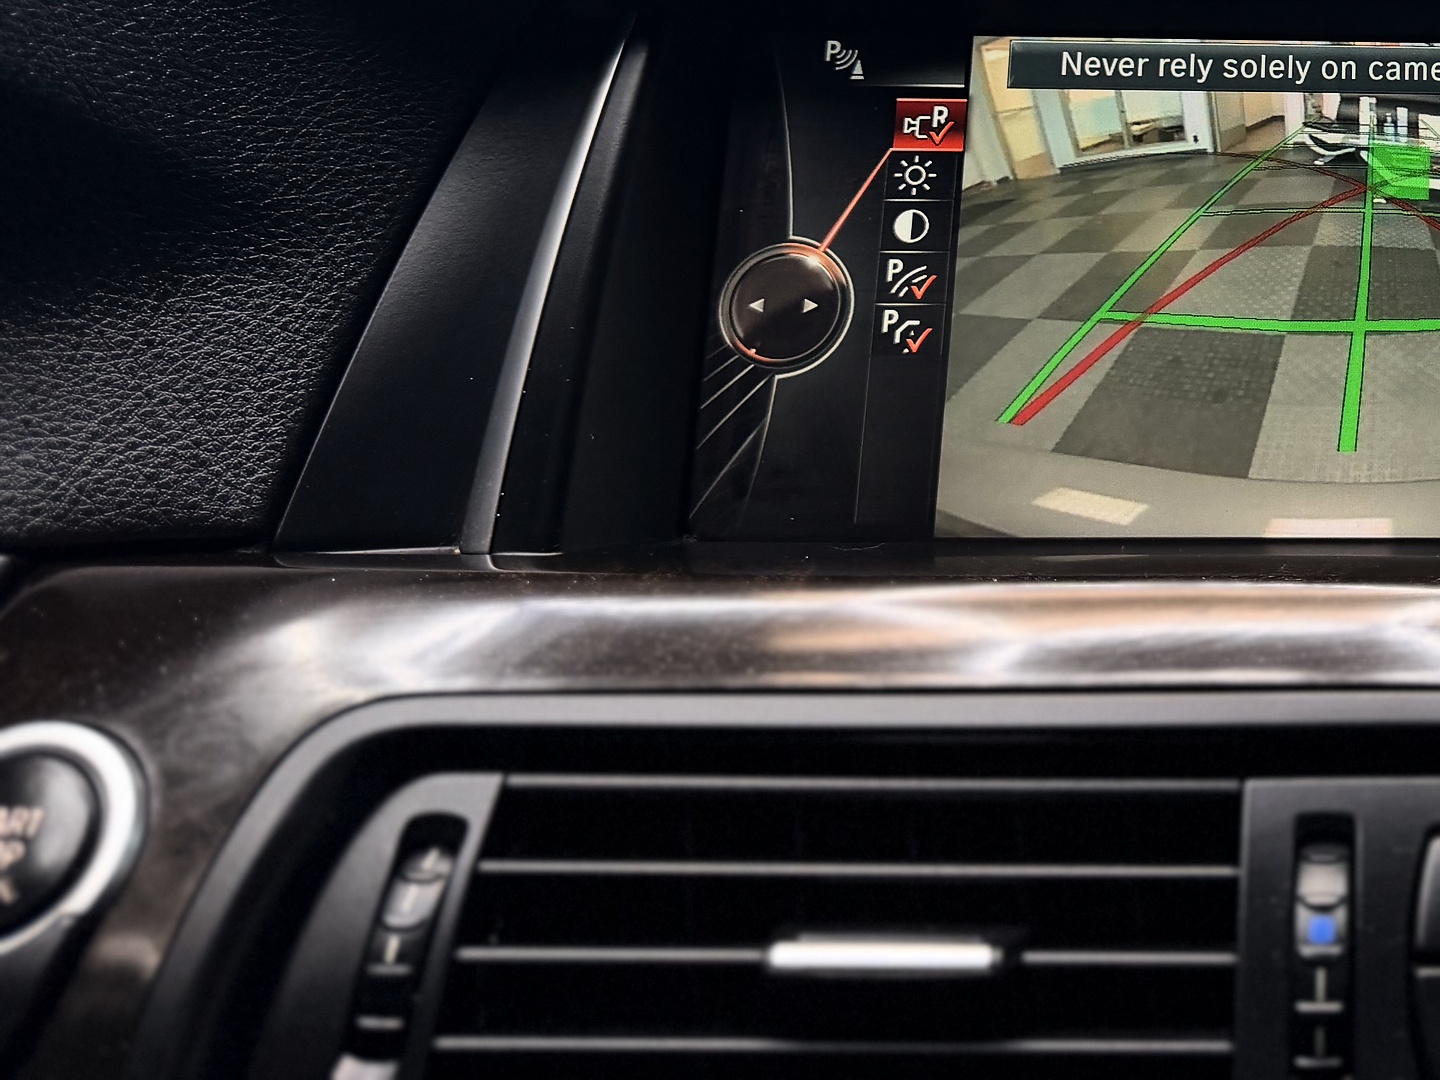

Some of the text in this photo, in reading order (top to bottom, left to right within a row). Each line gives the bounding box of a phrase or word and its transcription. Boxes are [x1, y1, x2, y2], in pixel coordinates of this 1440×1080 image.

[1060, 51, 1150, 77] Never
[1158, 53, 1214, 84] rely
[1223, 54, 1311, 85] solely
[1321, 60, 1357, 80] on
